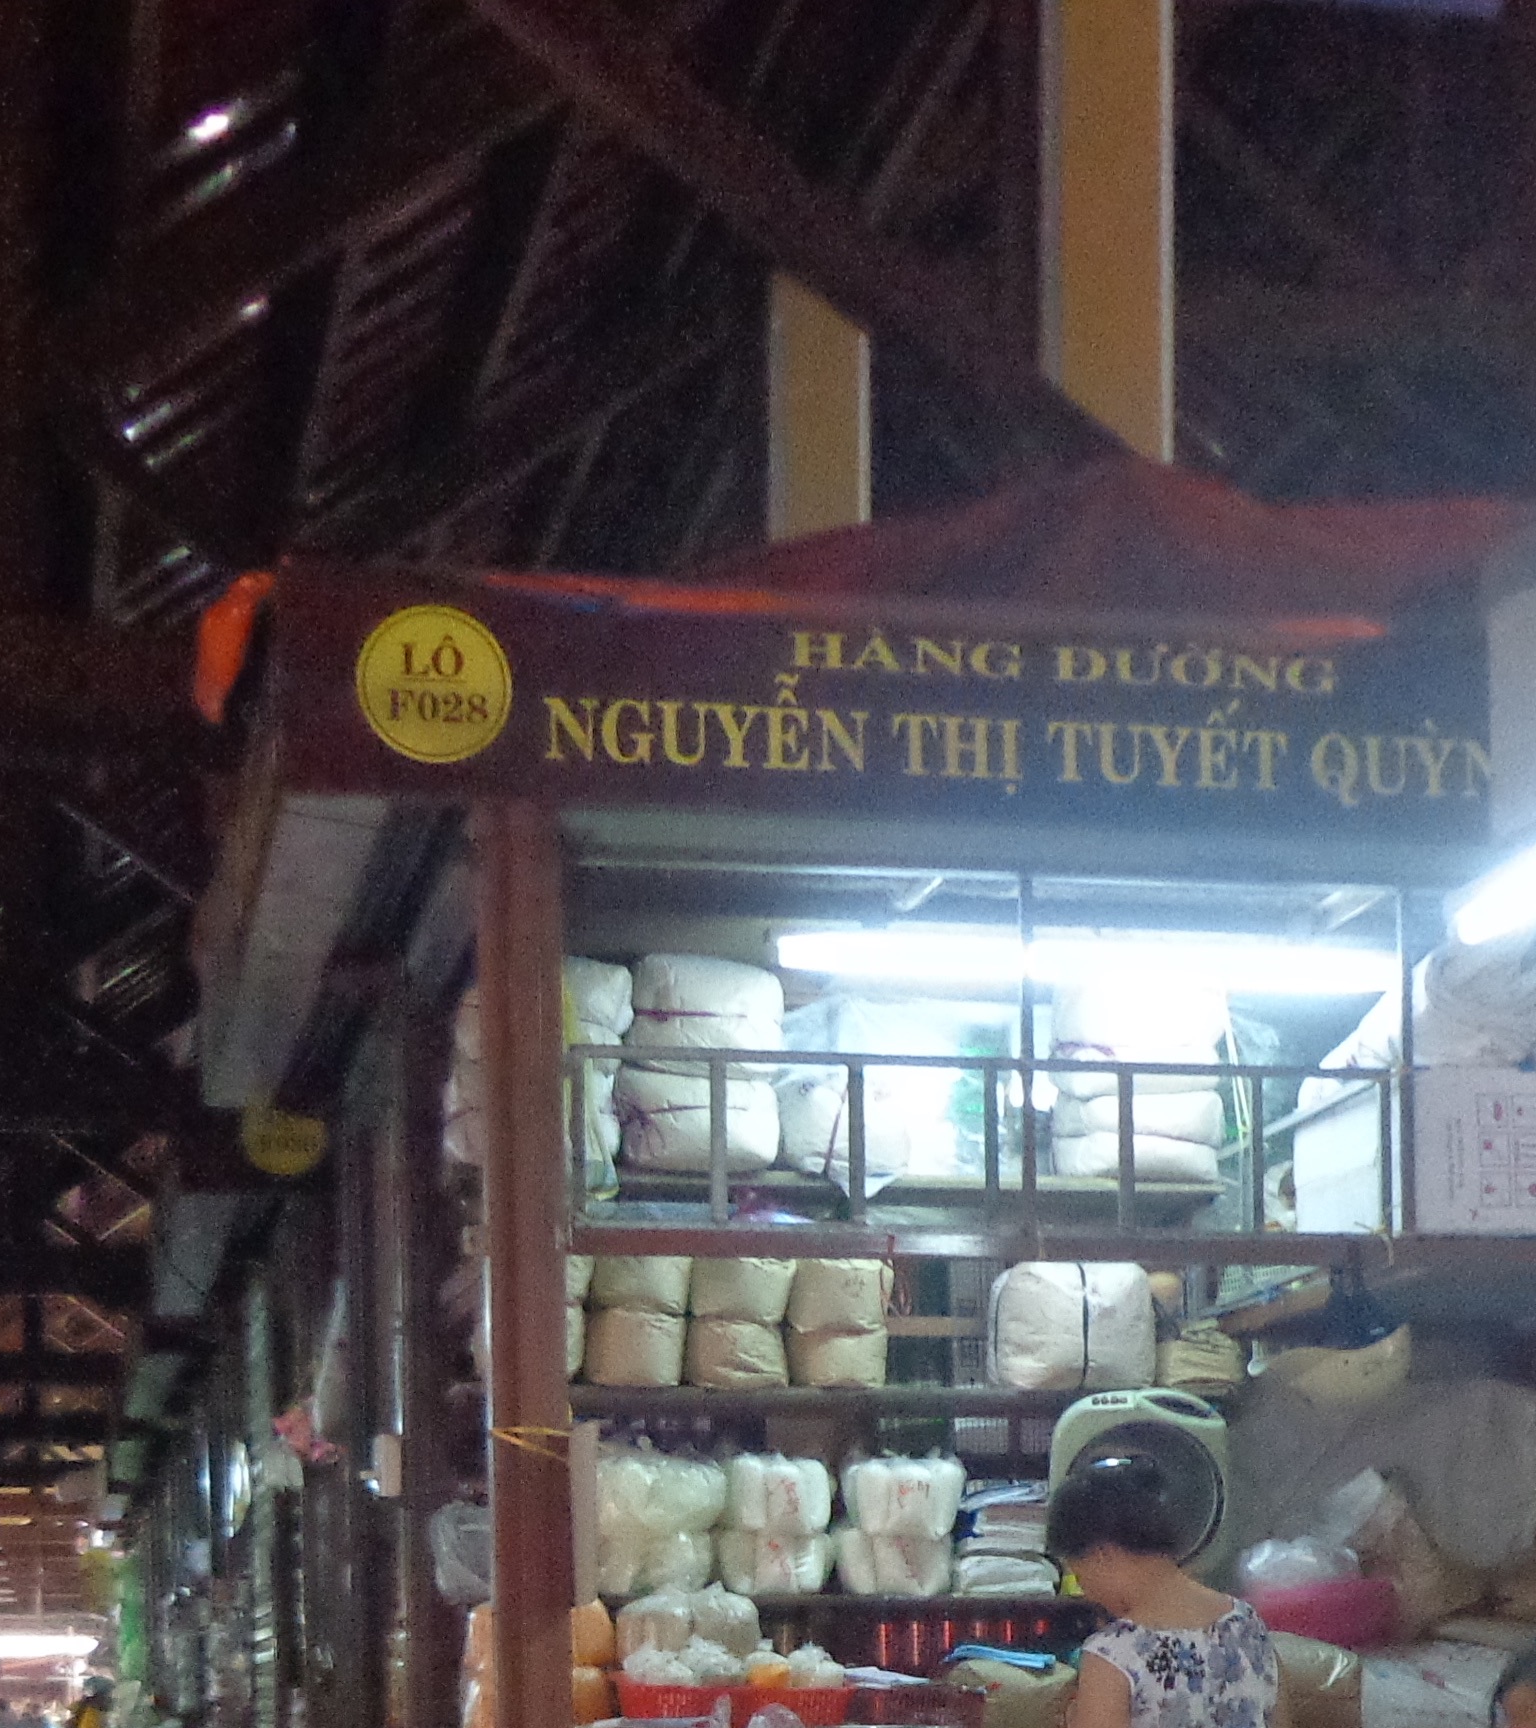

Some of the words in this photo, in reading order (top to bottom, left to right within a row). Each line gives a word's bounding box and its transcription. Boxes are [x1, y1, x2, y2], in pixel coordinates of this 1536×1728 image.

[400, 634, 466, 677] LÔ
[791, 627, 1023, 682] HÀNG
[388, 687, 490, 724] F028
[543, 672, 868, 773] NGUYỄN
[892, 711, 1024, 796] THỊ
[1047, 699, 1289, 792] TUYẾT
